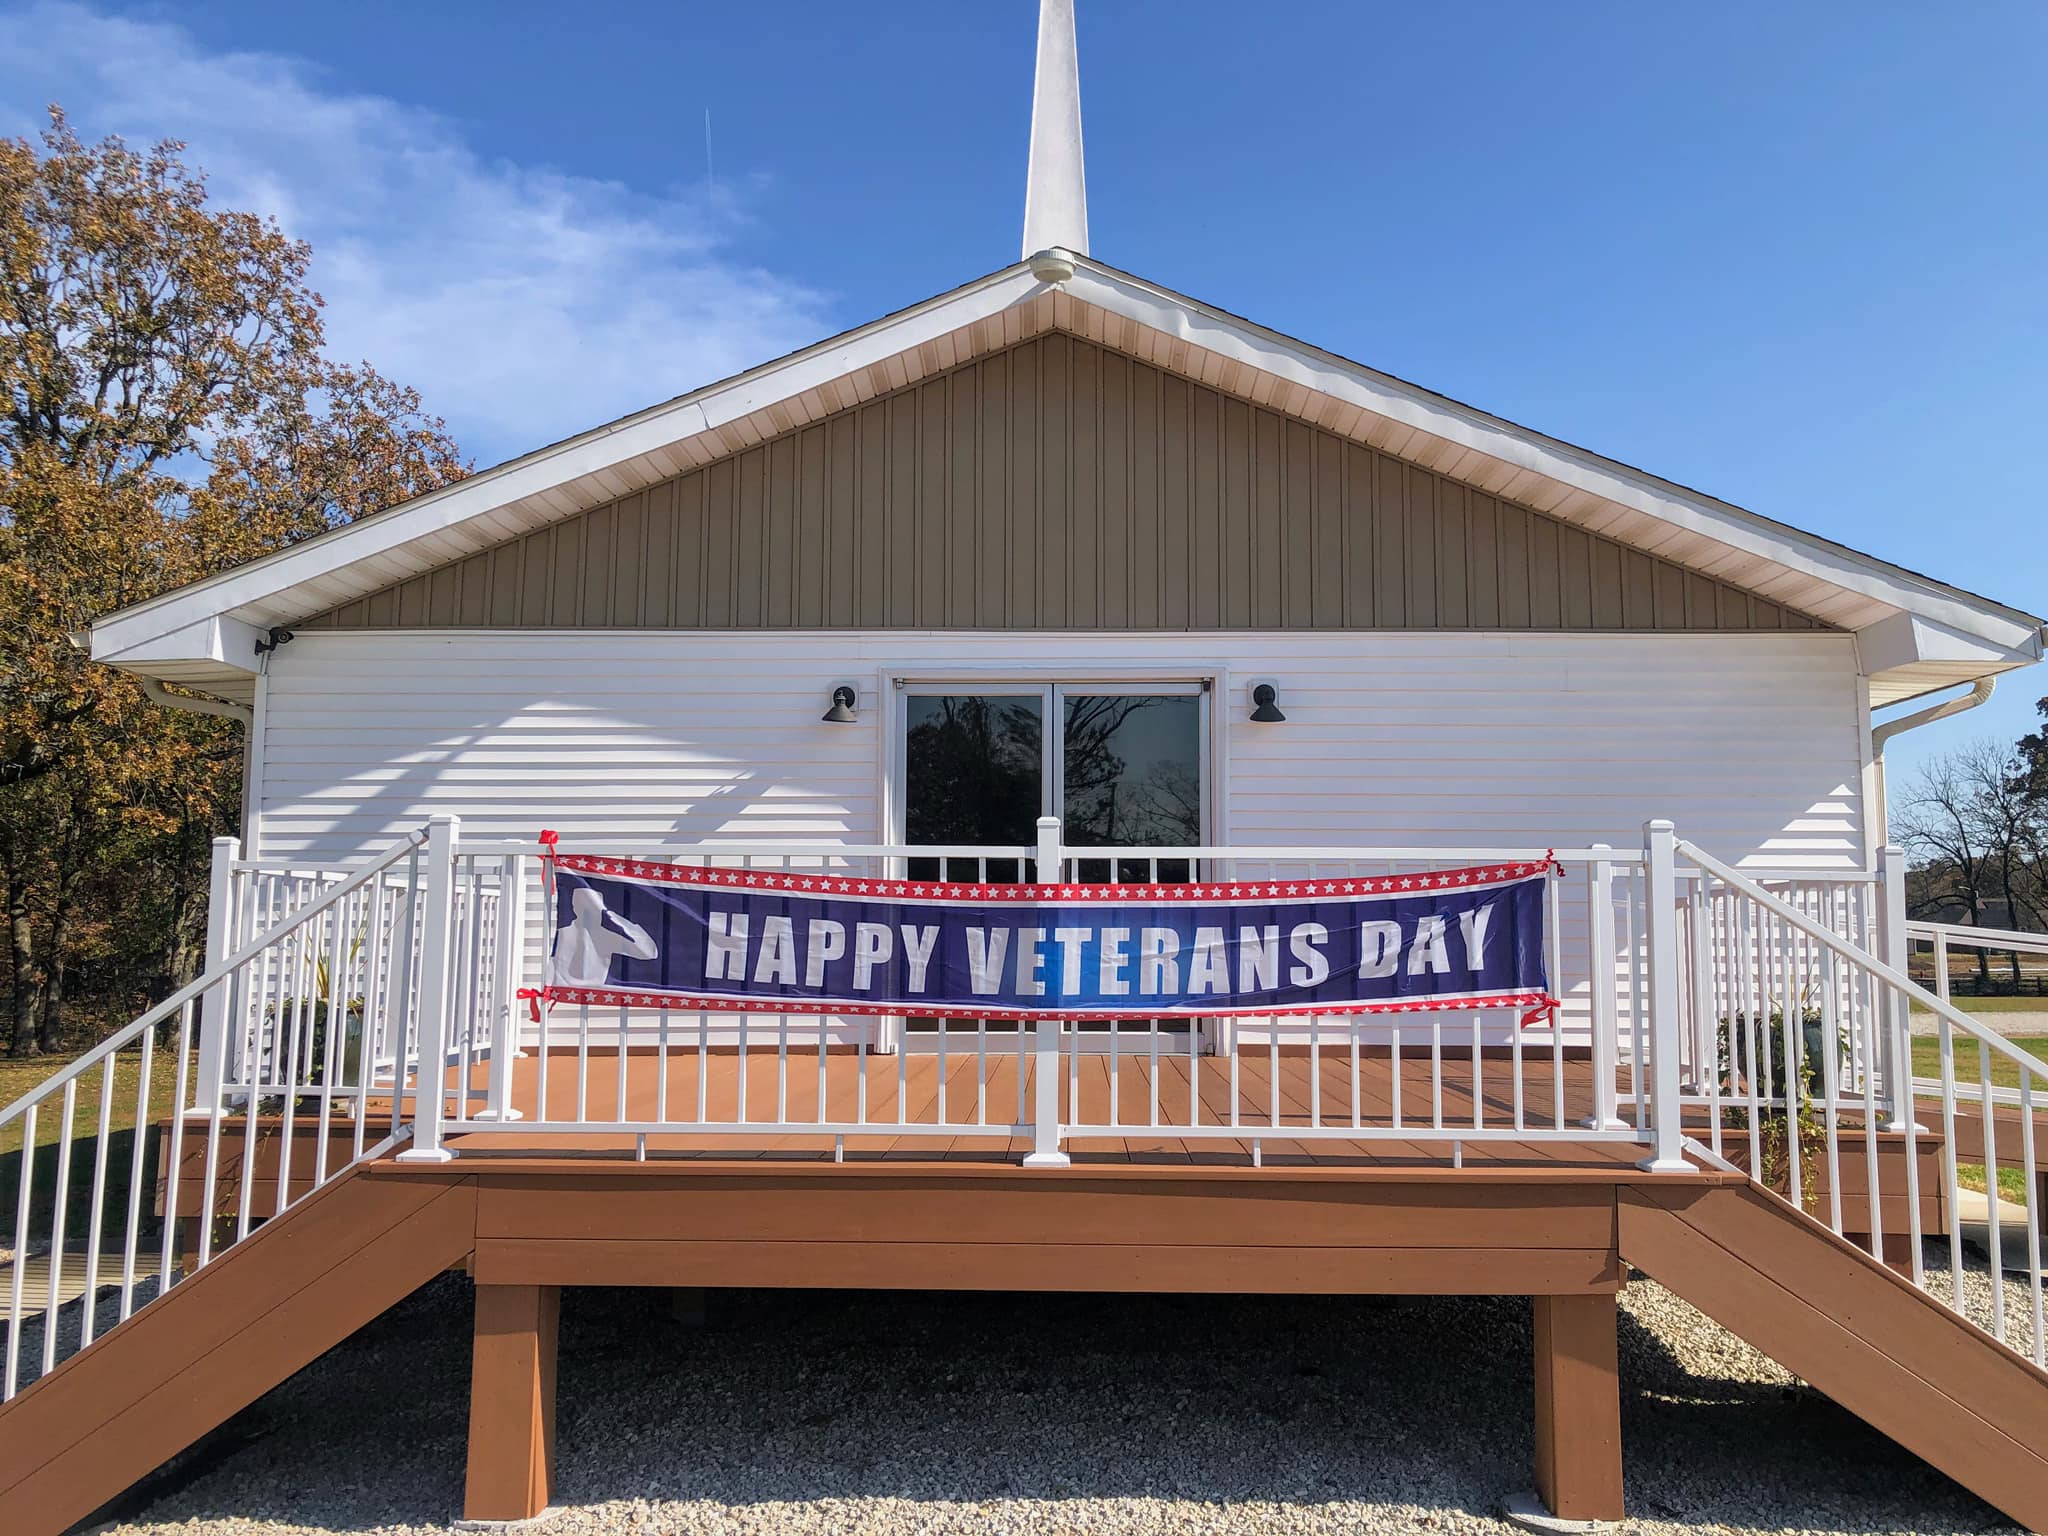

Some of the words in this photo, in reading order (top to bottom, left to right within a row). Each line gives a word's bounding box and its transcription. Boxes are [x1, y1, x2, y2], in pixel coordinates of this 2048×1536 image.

[705, 911, 941, 993] HAPPY
[965, 922, 1330, 996] VETERANS
[1358, 903, 1495, 979] DAY
